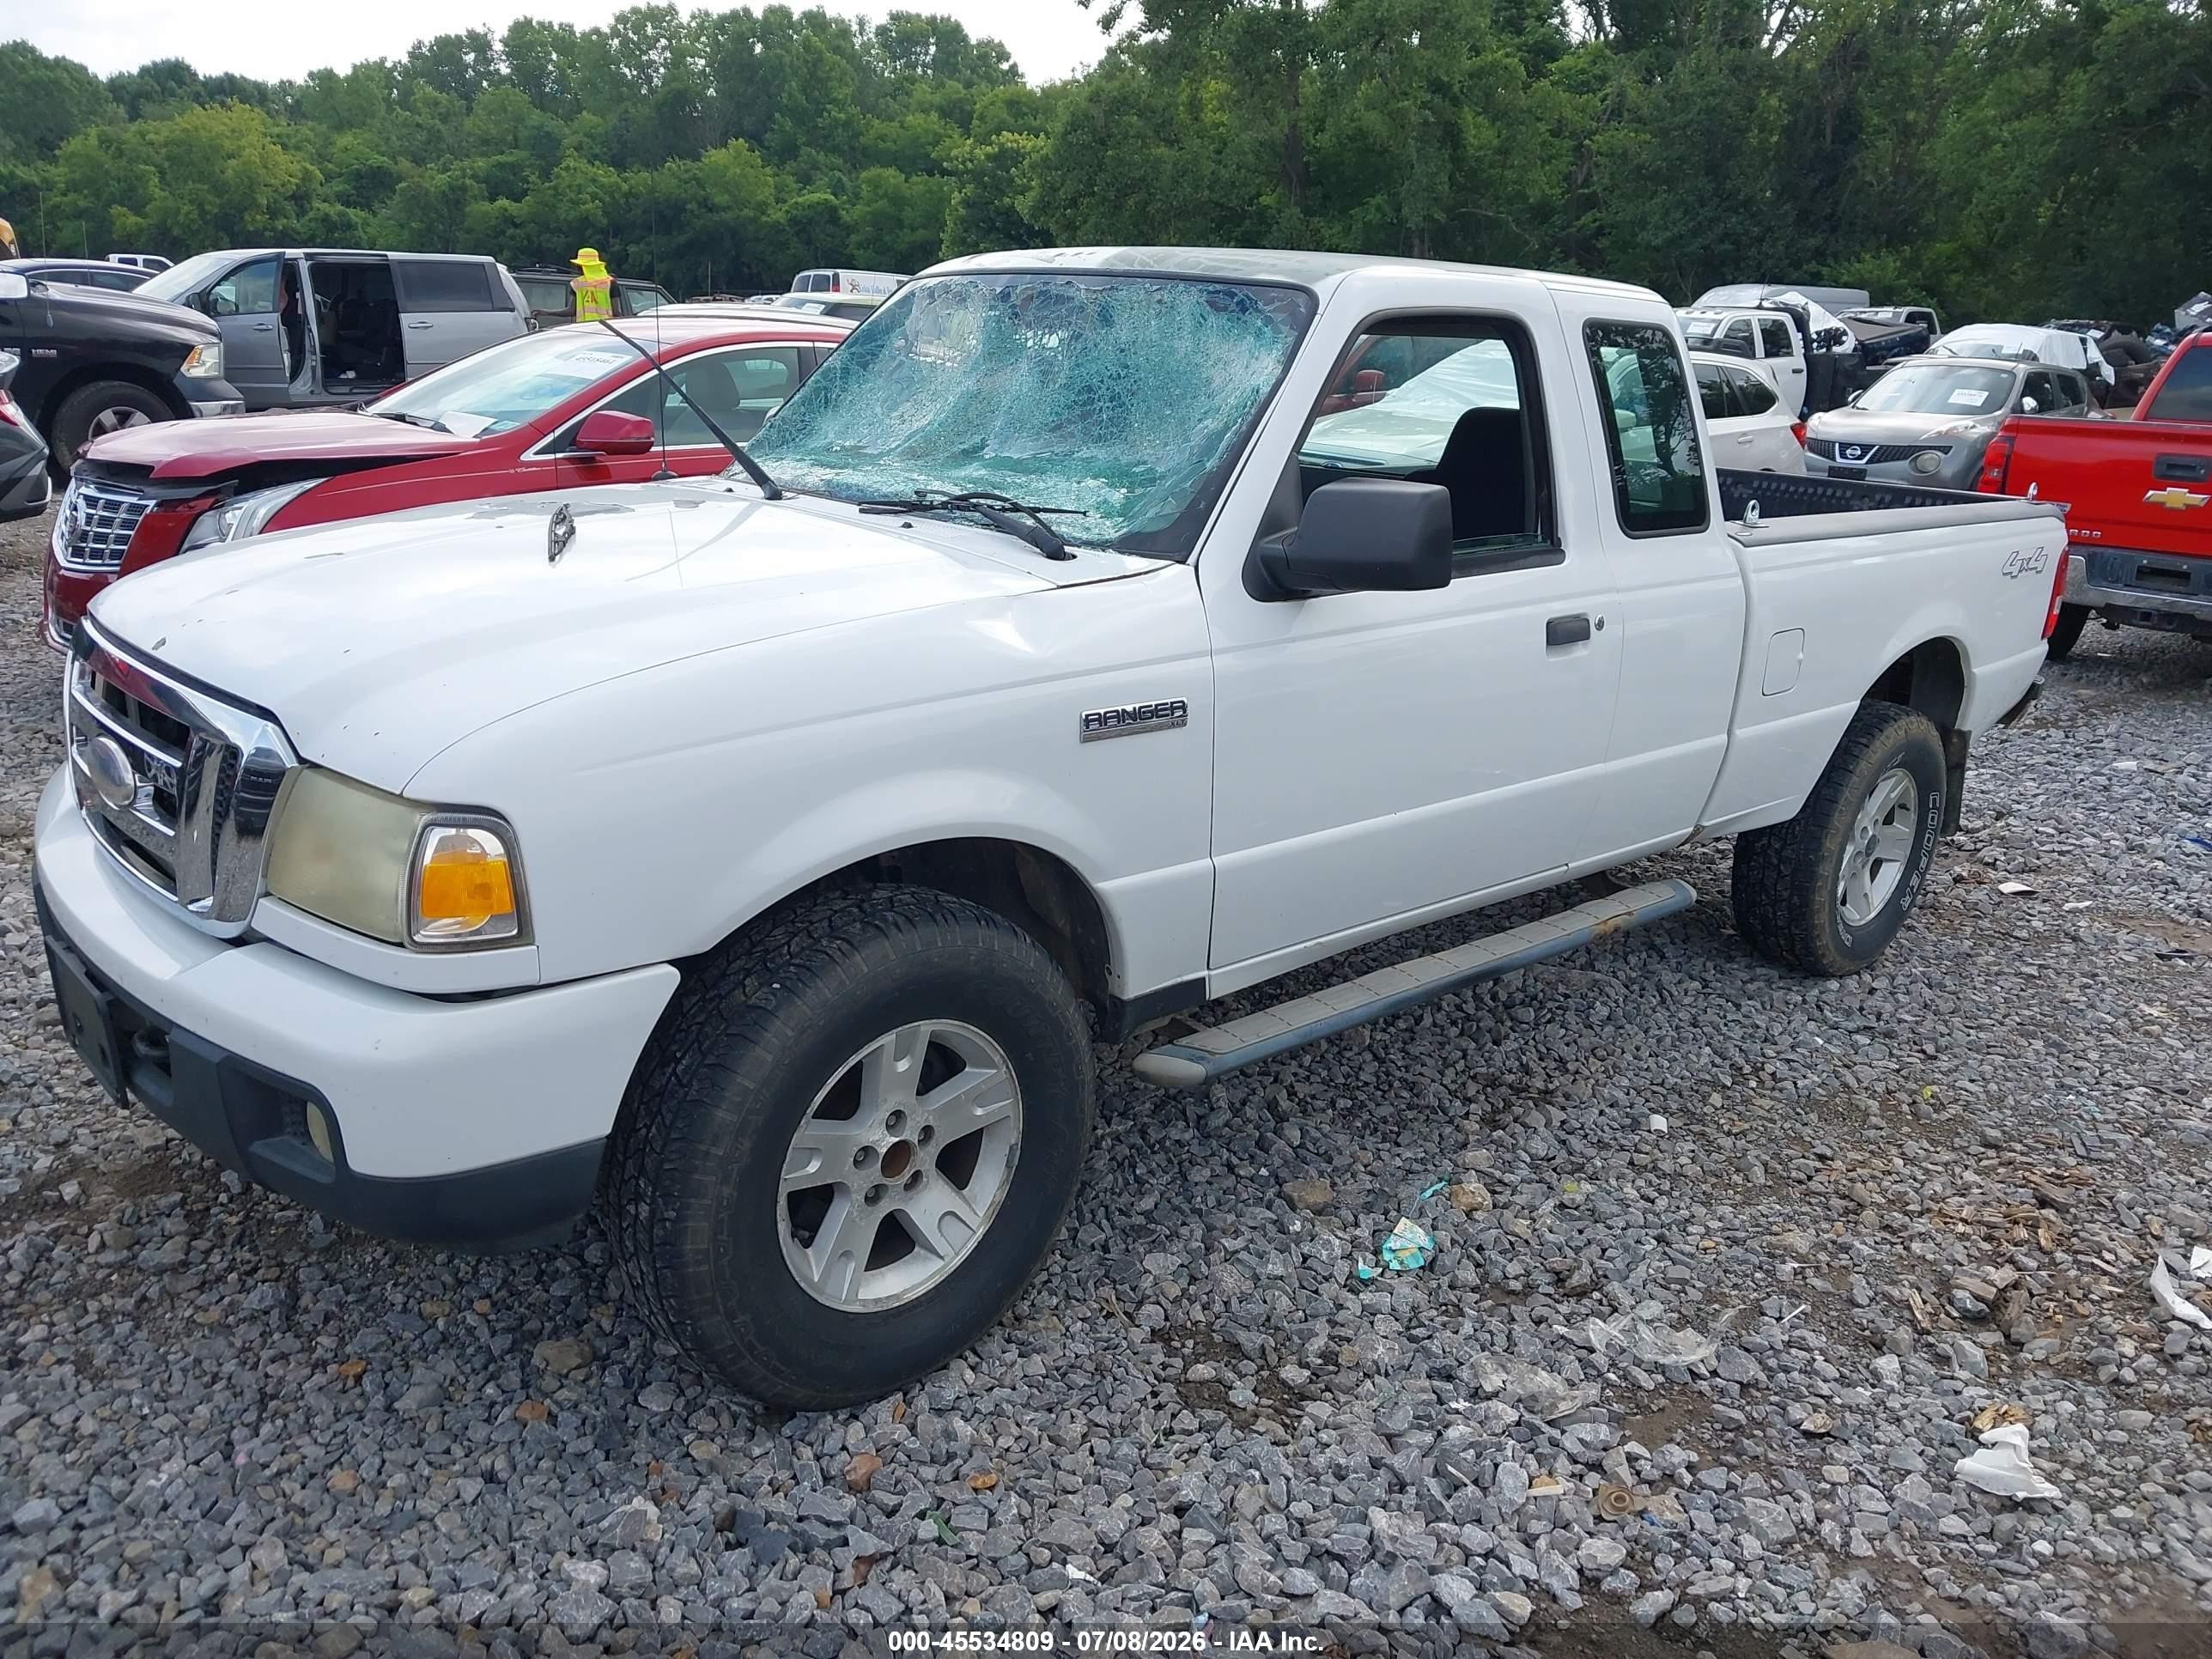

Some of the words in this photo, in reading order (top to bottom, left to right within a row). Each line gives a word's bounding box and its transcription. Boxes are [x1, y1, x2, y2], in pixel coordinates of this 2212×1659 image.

[2002, 546, 2048, 579] 4x4
[1084, 700, 1188, 730] RANGER
[1168, 720, 1186, 729] XLT
[1900, 792, 1940, 911] COOPER
